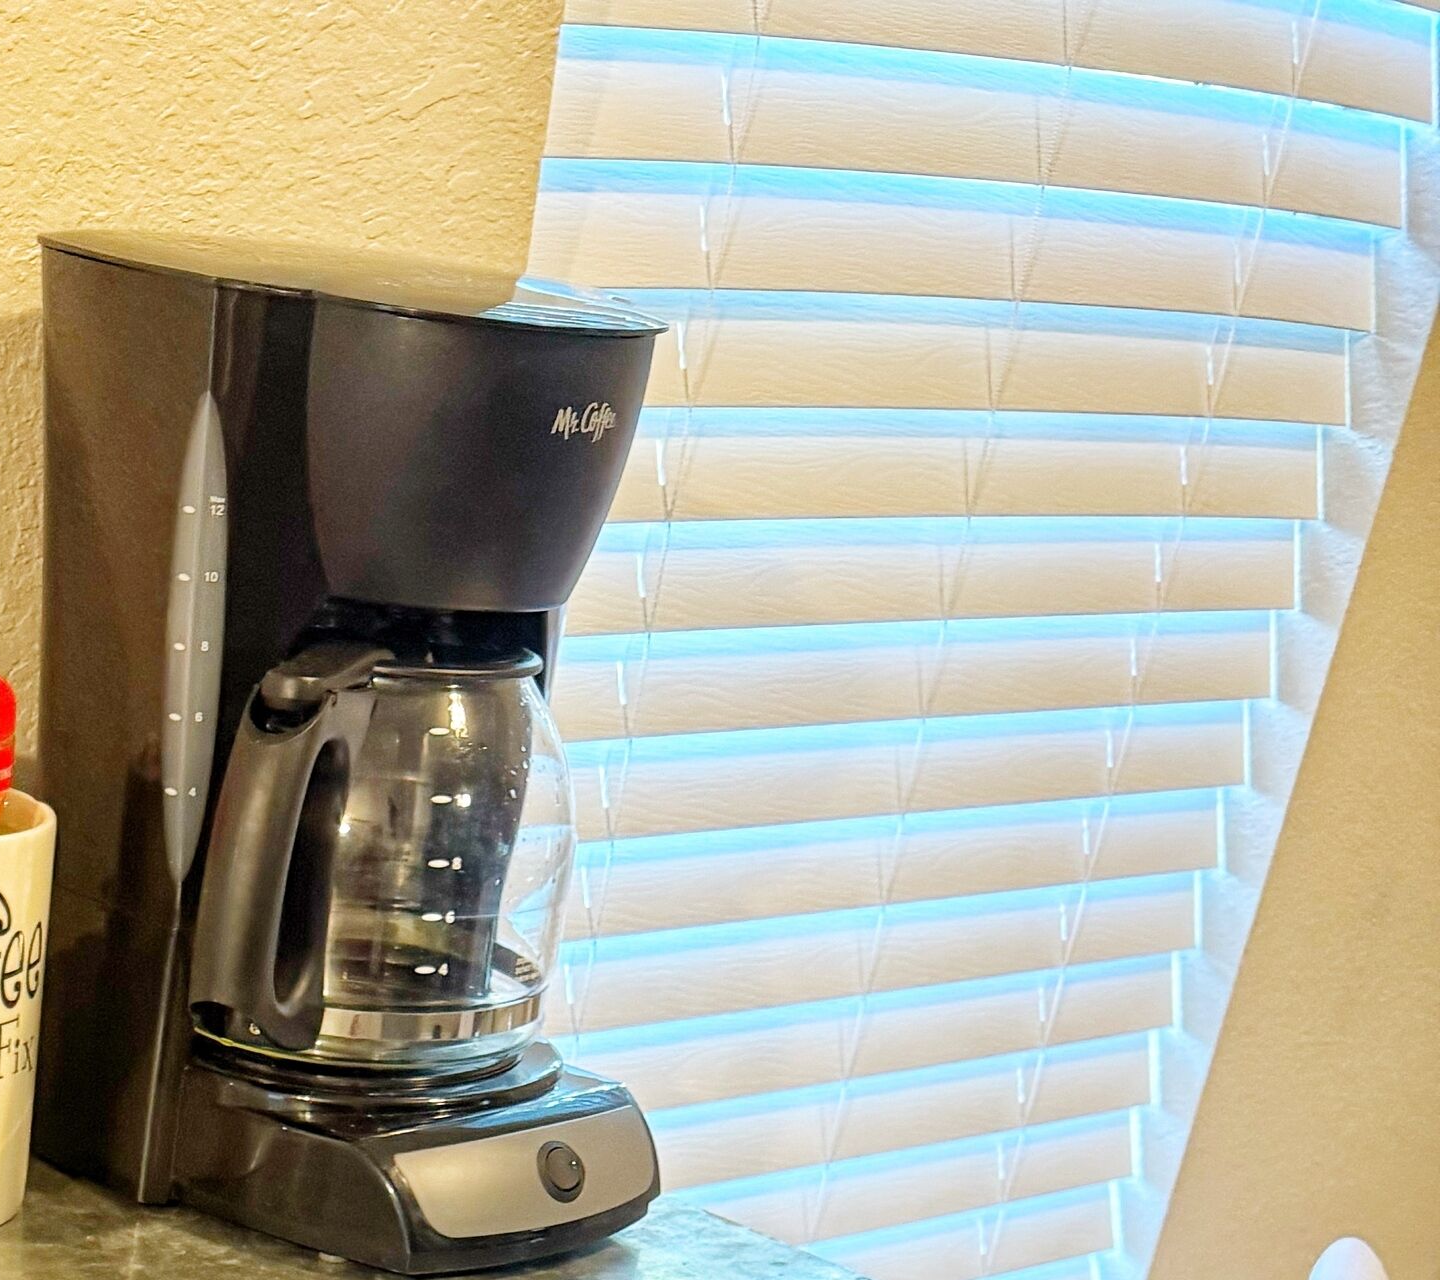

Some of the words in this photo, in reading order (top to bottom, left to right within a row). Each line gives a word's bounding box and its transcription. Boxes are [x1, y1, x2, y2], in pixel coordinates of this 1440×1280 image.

[210, 504, 225, 516] 12
[204, 571, 219, 583] 10
[200, 640, 209, 652] 8
[194, 711, 203, 723] 6
[188, 786, 197, 797] 4
[451, 856, 462, 870] 8
[445, 910, 456, 924] 6
